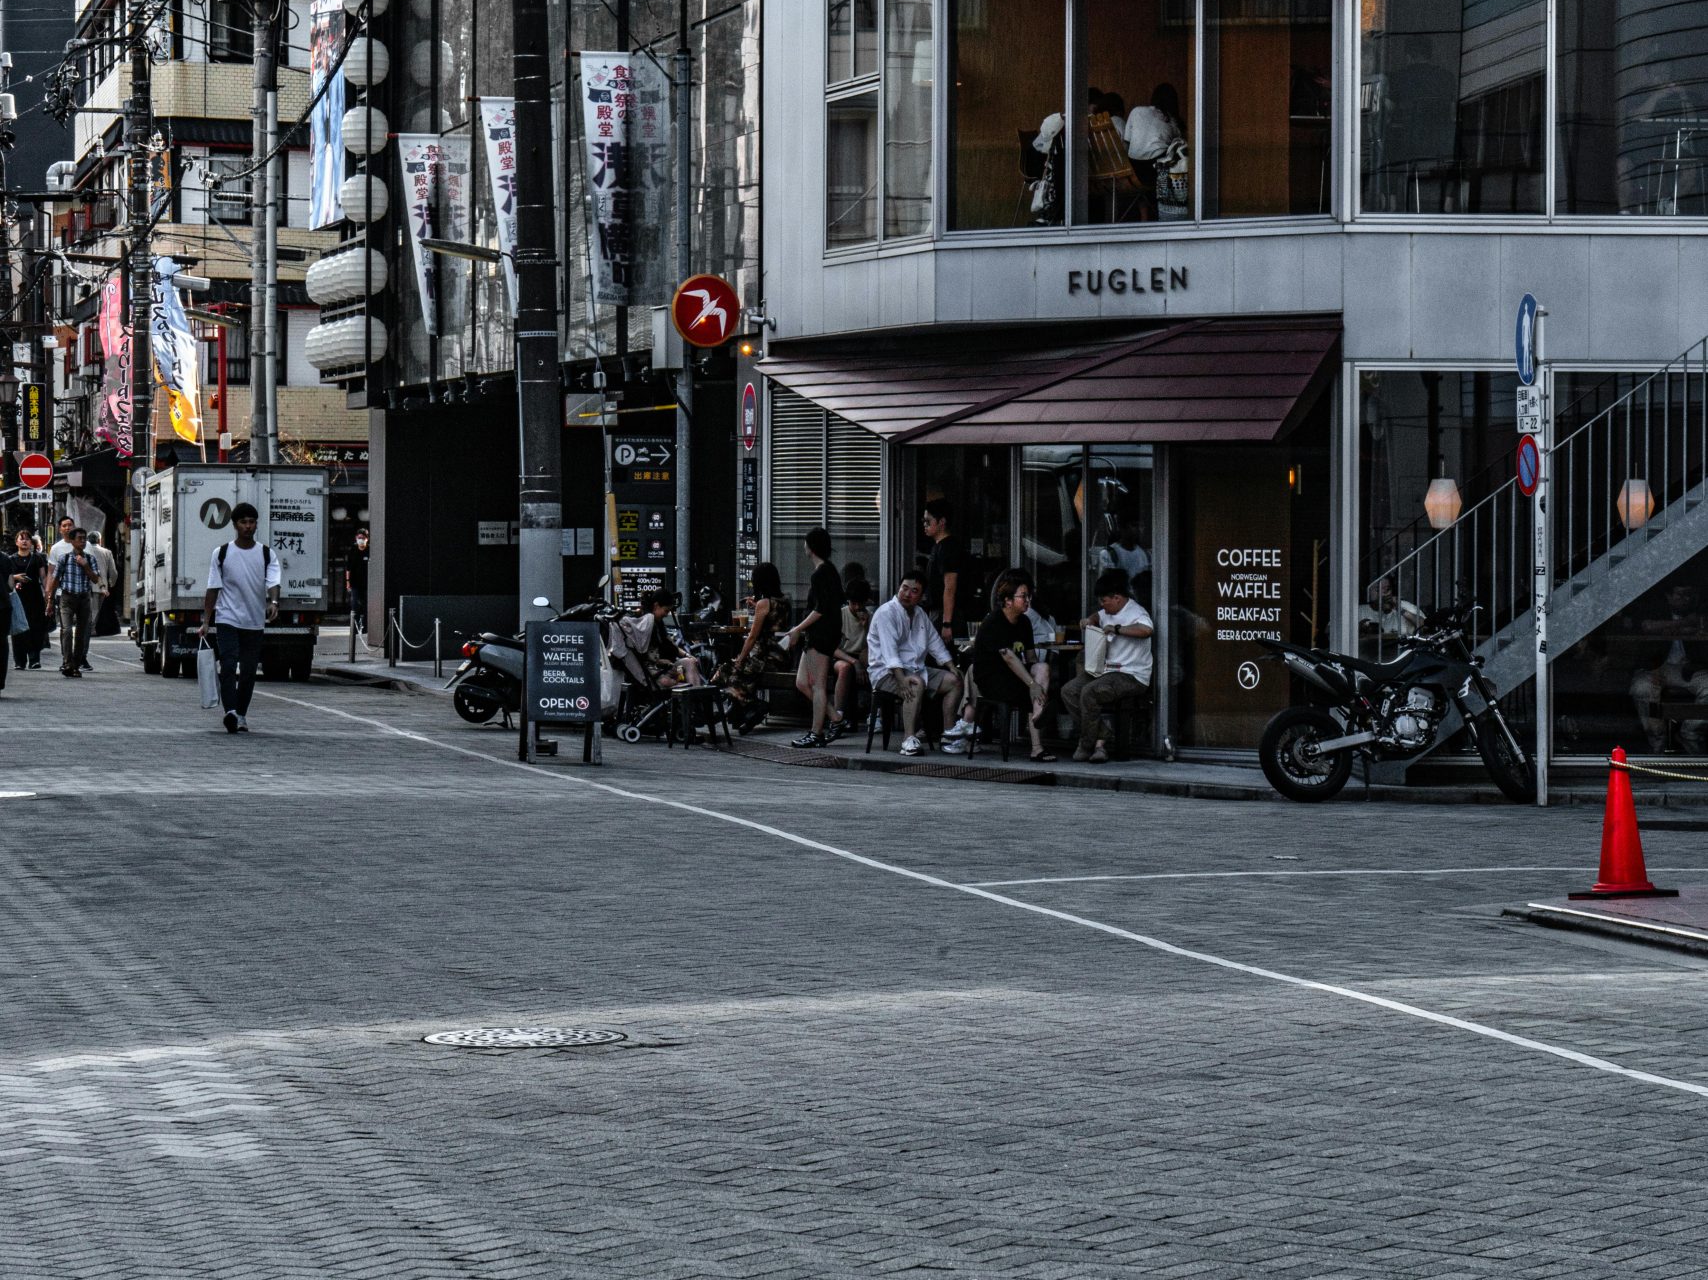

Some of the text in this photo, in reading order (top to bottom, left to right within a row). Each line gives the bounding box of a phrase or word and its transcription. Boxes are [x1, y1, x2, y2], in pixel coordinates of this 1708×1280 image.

[597, 105, 613, 137] 殿堂
[498, 141, 515, 170] 殿堂
[414, 174, 428, 201] 殿堂
[1068, 266, 1187, 296] FUGLEN
[270, 511, 315, 522] 西原商会
[620, 511, 639, 531] 空
[746, 523, 753, 533] 6
[273, 537, 303, 551] 水村
[620, 540, 639, 560] 空
[1217, 548, 1282, 567] COFFEE
[288, 579, 305, 589] NO.44
[1231, 573, 1268, 581] NORWEGIAN
[1217, 581, 1281, 599] WAFFLE
[1217, 606, 1282, 622] BREAKFAST
[542, 634, 585, 645] COFFEE
[542, 652, 585, 662] WAFFLE
[539, 697, 575, 709] OPEN
